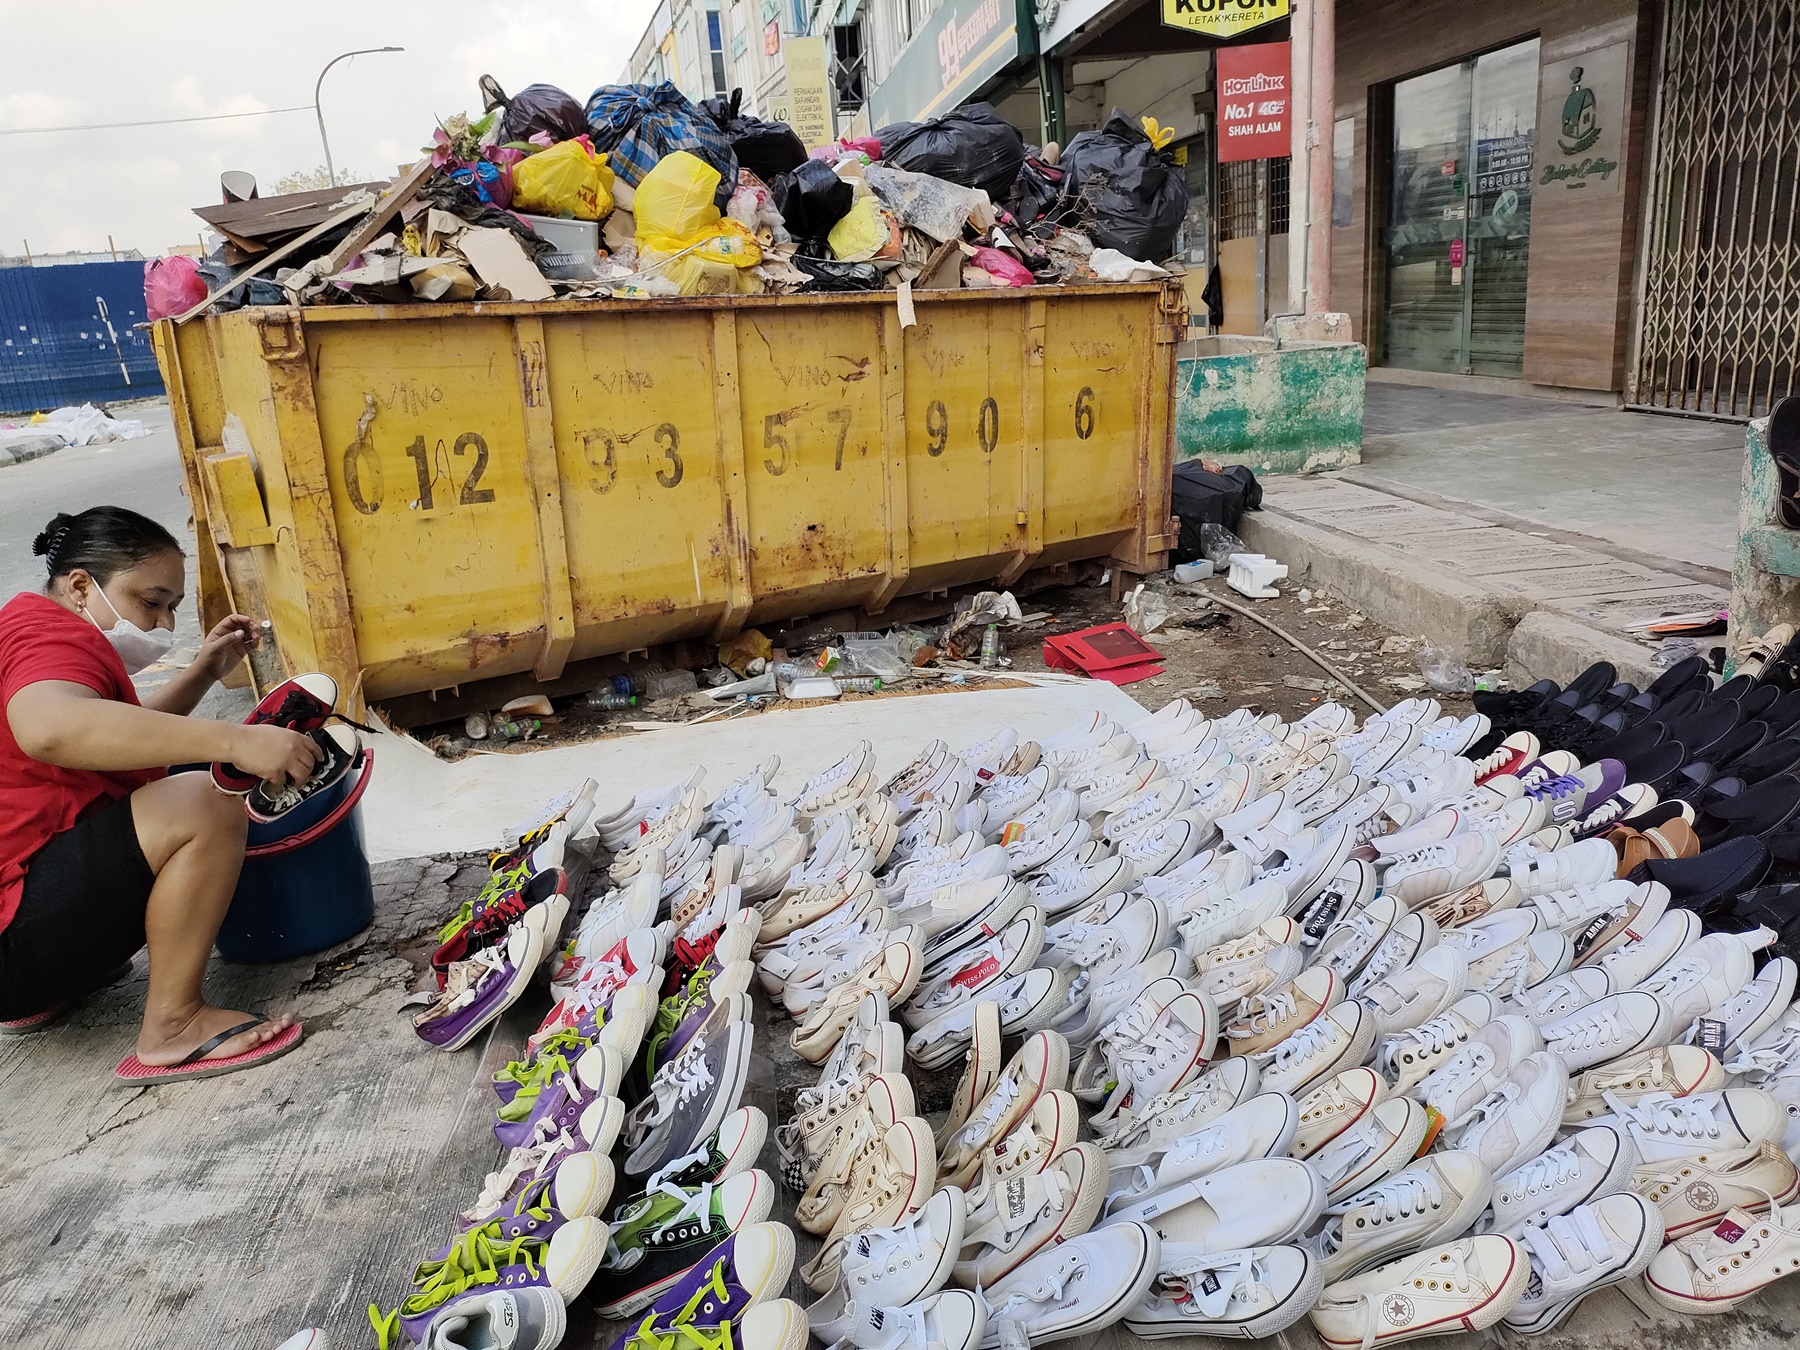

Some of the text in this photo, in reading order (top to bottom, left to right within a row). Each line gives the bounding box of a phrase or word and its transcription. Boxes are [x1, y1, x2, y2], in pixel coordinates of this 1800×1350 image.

[1224, 11, 1265, 21] KERETA
[938, 18, 960, 91] 99
[1223, 73, 1285, 96] HOTLINK
[1228, 121, 1281, 137] SHAH ALAM
[1074, 386, 1096, 440] 6
[1586, 918, 1607, 939] AMAX
[1704, 1022, 1716, 1047] AMAX
